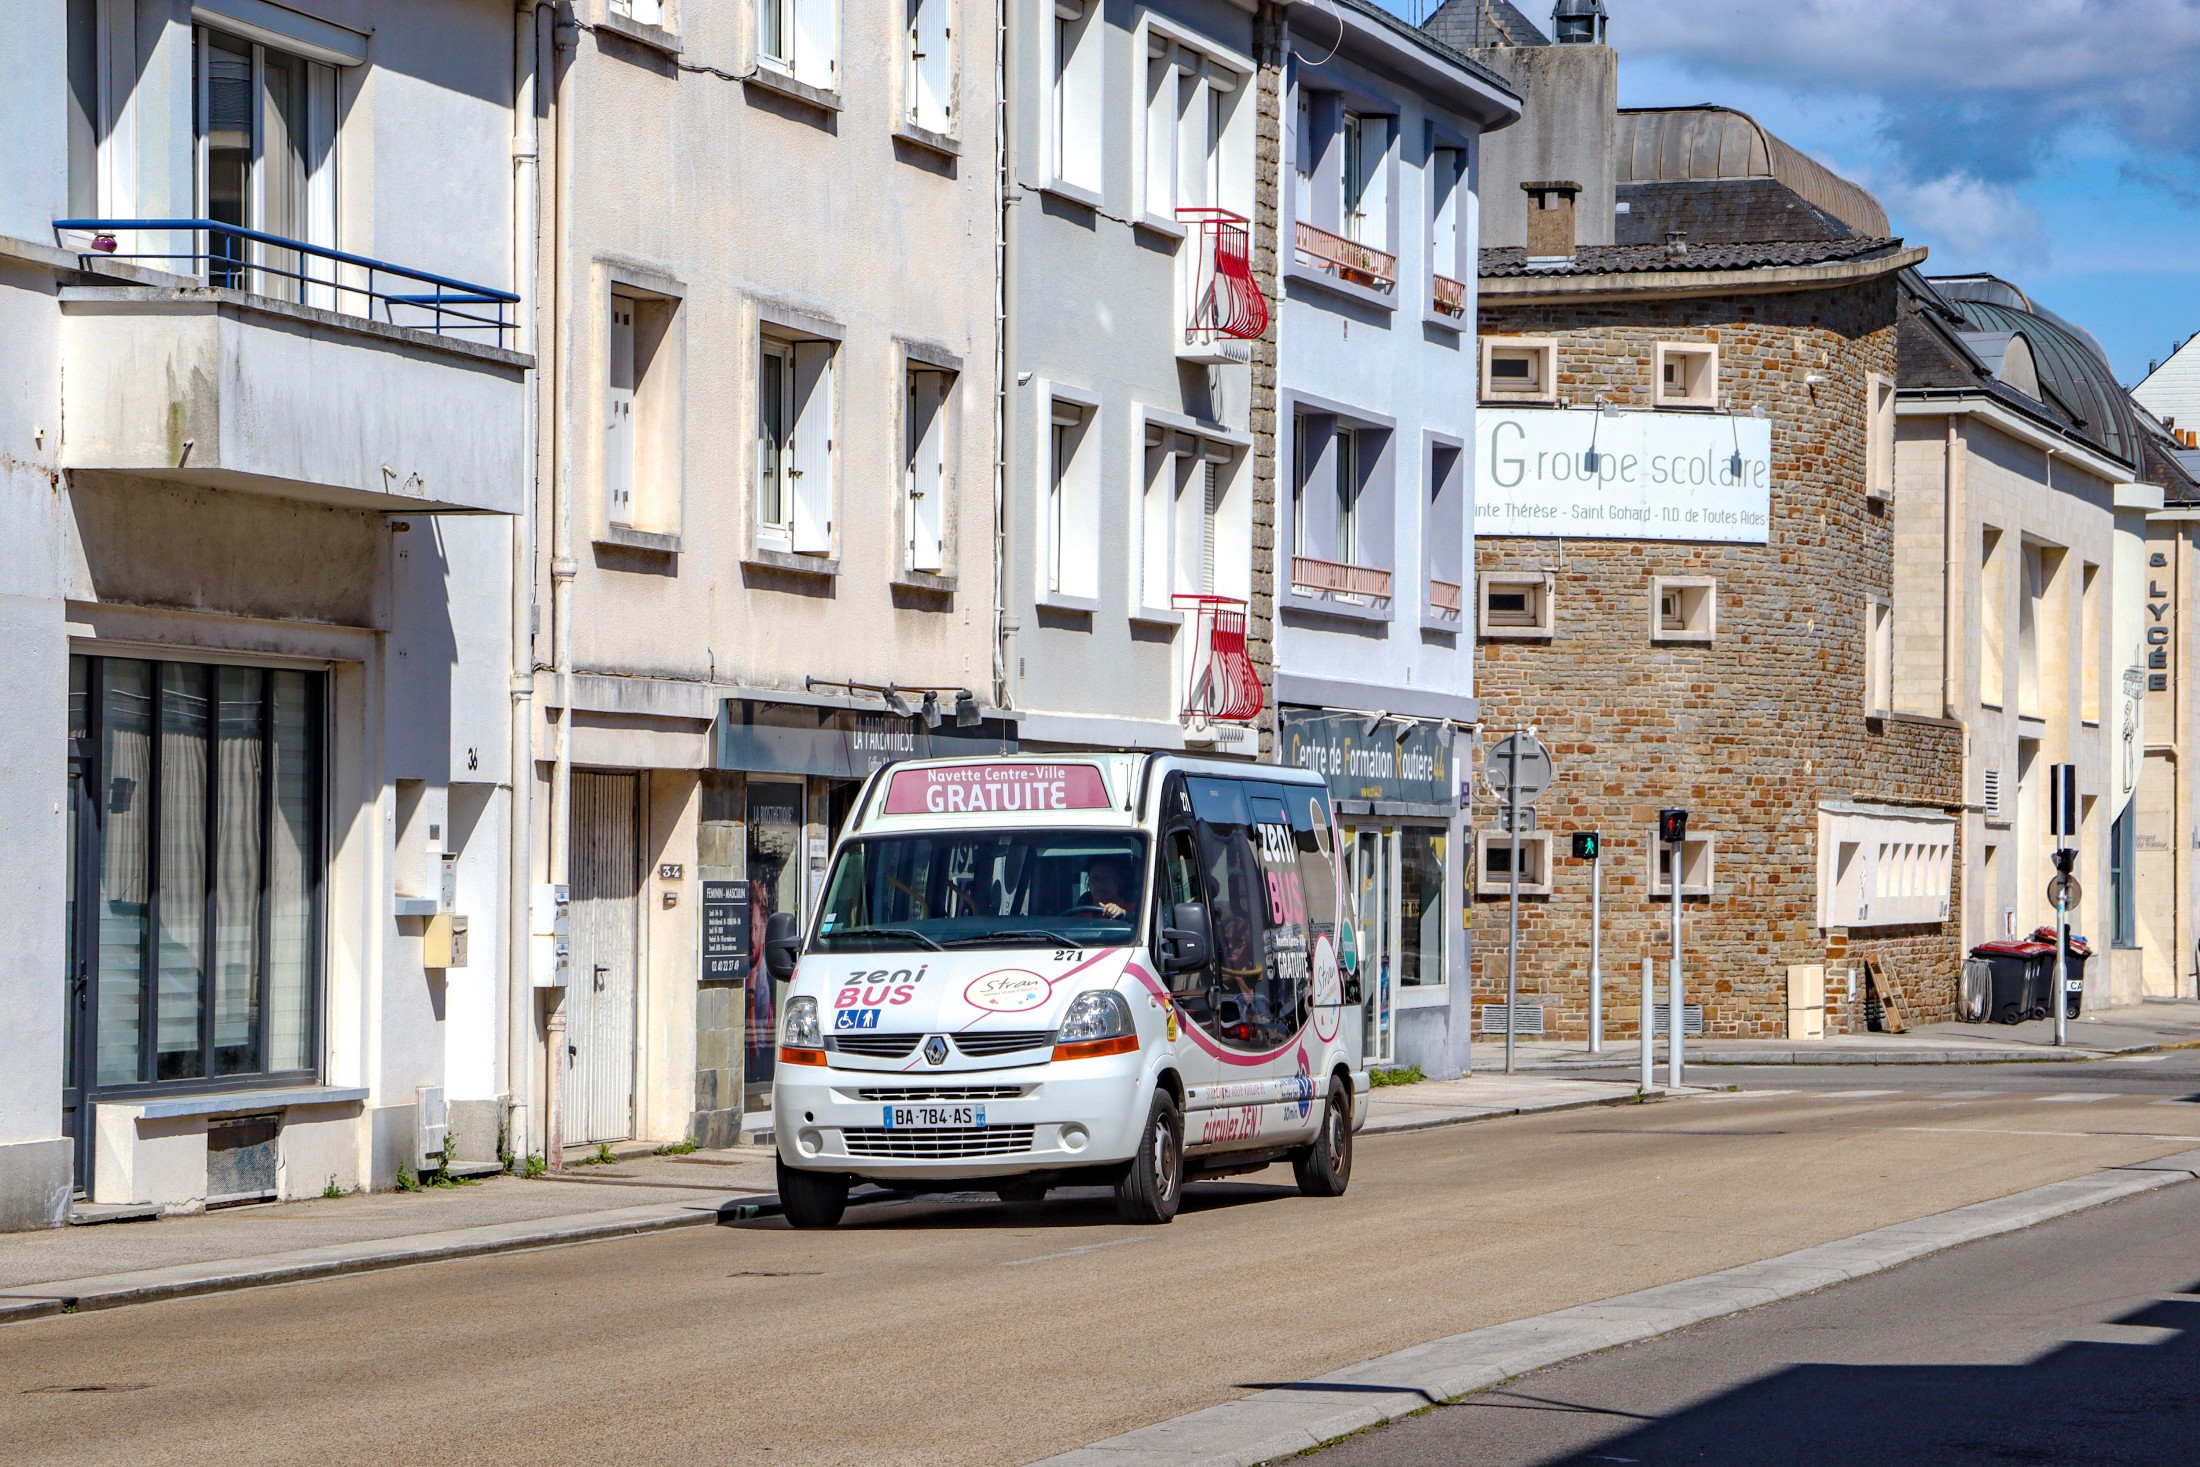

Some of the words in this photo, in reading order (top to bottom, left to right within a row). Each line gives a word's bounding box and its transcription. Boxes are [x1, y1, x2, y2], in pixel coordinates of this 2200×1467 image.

[1491, 421, 1637, 490] Groupe
[1505, 503, 1557, 518] Thérèse
[1572, 504, 1604, 520] Saint
[1609, 505, 1650, 521] Gohard
[1685, 509, 1698, 522] de
[1702, 509, 1738, 524] Toutes
[1741, 510, 1765, 526] Aides
[2147, 580, 2169, 691] LYCÉE
[854, 716, 863, 750] LA
[468, 748, 478, 771] 36
[1292, 734, 1326, 775] Centre
[1329, 737, 1341, 776] de
[1344, 738, 1392, 778] Formation
[1395, 744, 1433, 782] Routière
[1434, 745, 1445, 781] 44
[928, 768, 981, 783] Navette
[985, 766, 1066, 781] Centre-Ville
[926, 781, 1067, 812] GRATUITE
[1257, 809, 1295, 863] zeni
[663, 866, 681, 878] 34
[1268, 871, 1304, 925] BUS
[1054, 950, 1083, 962] 271
[1277, 952, 1309, 979] GRATUITE
[844, 964, 928, 986] zeni
[980, 977, 1039, 993] Stran
[834, 985, 915, 1009] BUS
[895, 1108, 972, 1124] BA-784-AS
[1202, 1108, 1238, 1143] circulez
[1241, 1105, 1258, 1139] ZEN
